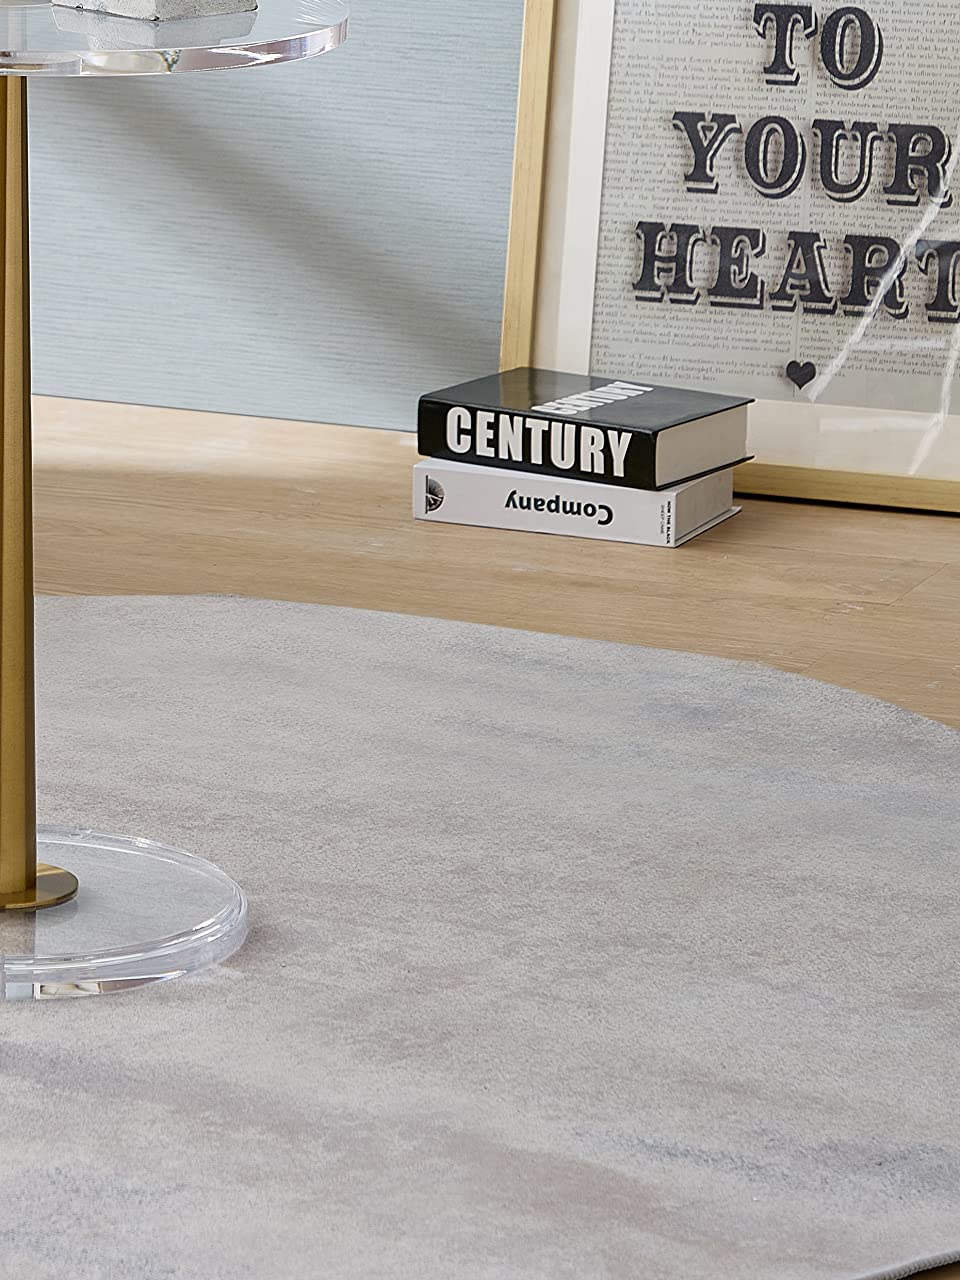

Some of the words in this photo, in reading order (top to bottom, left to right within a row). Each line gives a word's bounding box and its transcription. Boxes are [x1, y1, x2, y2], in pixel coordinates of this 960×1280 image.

[753, 3, 883, 91] TO
[672, 111, 953, 208] YOUR
[530, 381, 655, 415] CENTURY
[446, 406, 633, 478] CENTURY
[505, 489, 614, 526] Company
